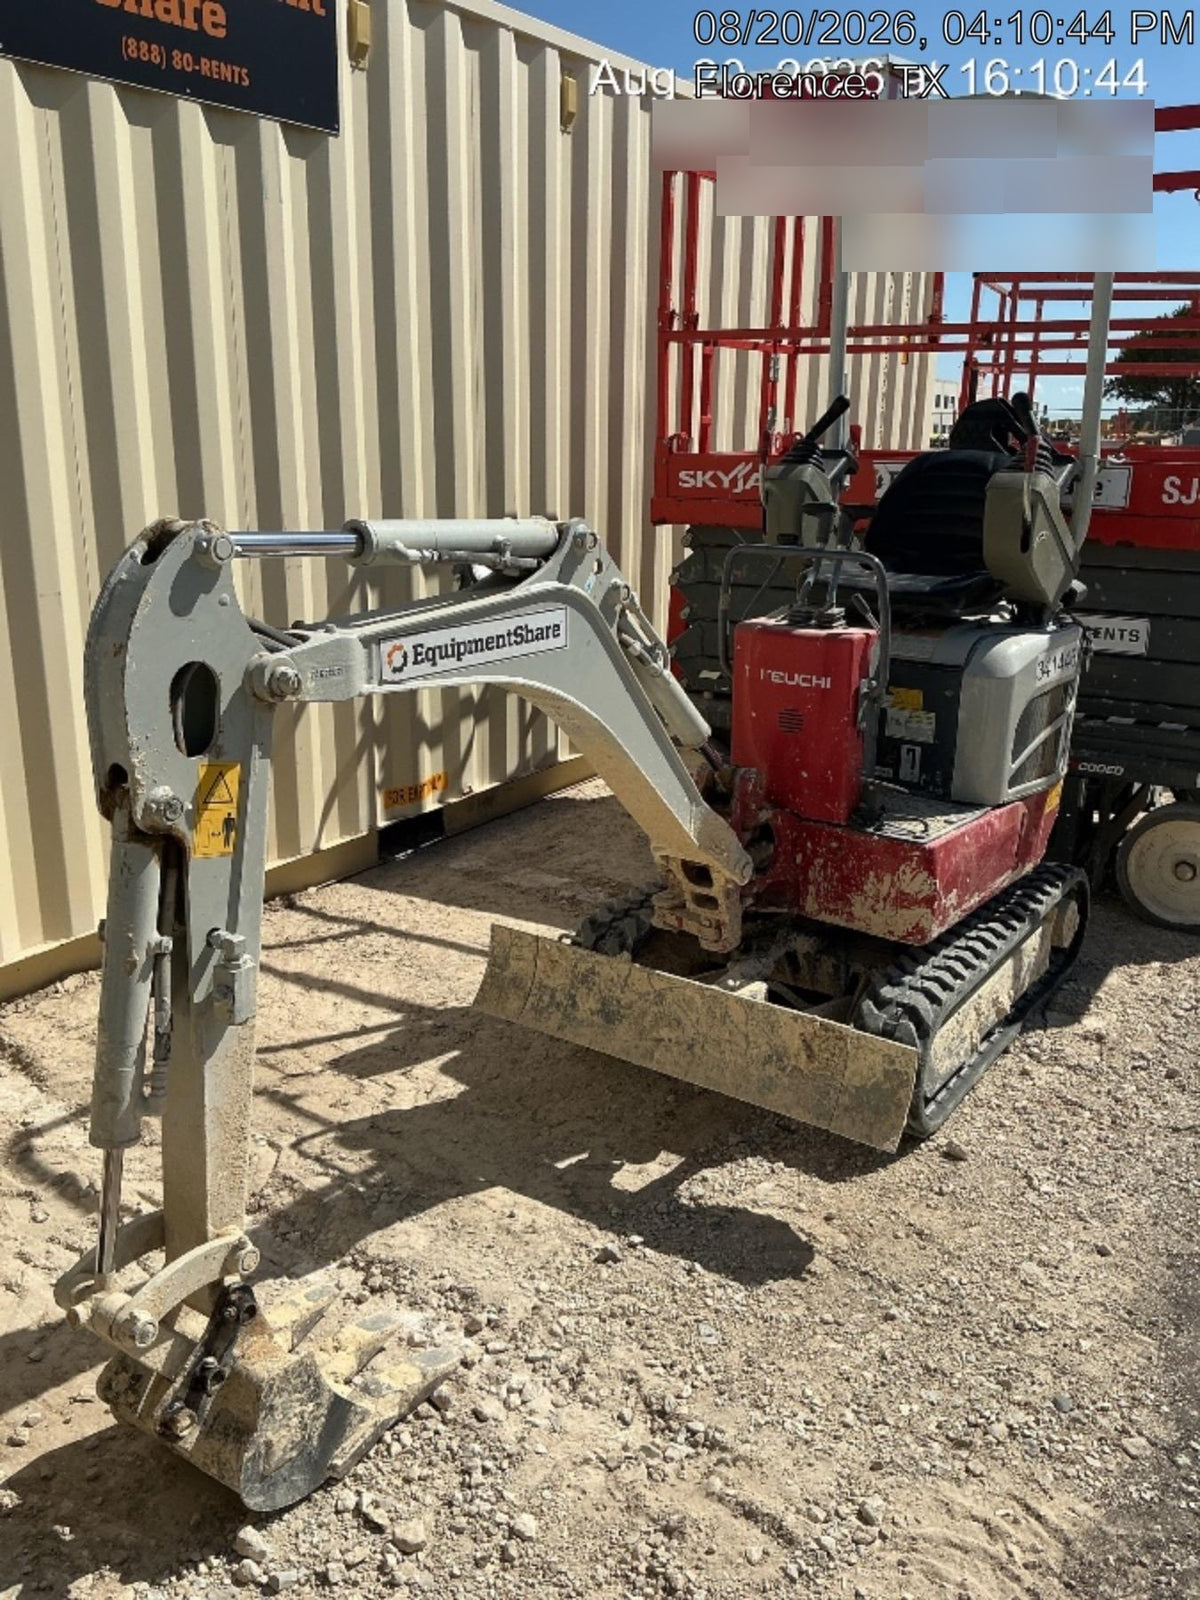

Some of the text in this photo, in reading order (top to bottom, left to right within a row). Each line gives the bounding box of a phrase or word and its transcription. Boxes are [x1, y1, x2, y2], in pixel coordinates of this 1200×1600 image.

[122, 36, 250, 86] (888) 80-RENTS
[1161, 475, 1200, 506] SJ
[412, 622, 562, 667] EquipmentShare
[1084, 626, 1140, 643] ENTS
[744, 664, 832, 689] TEUCHI
